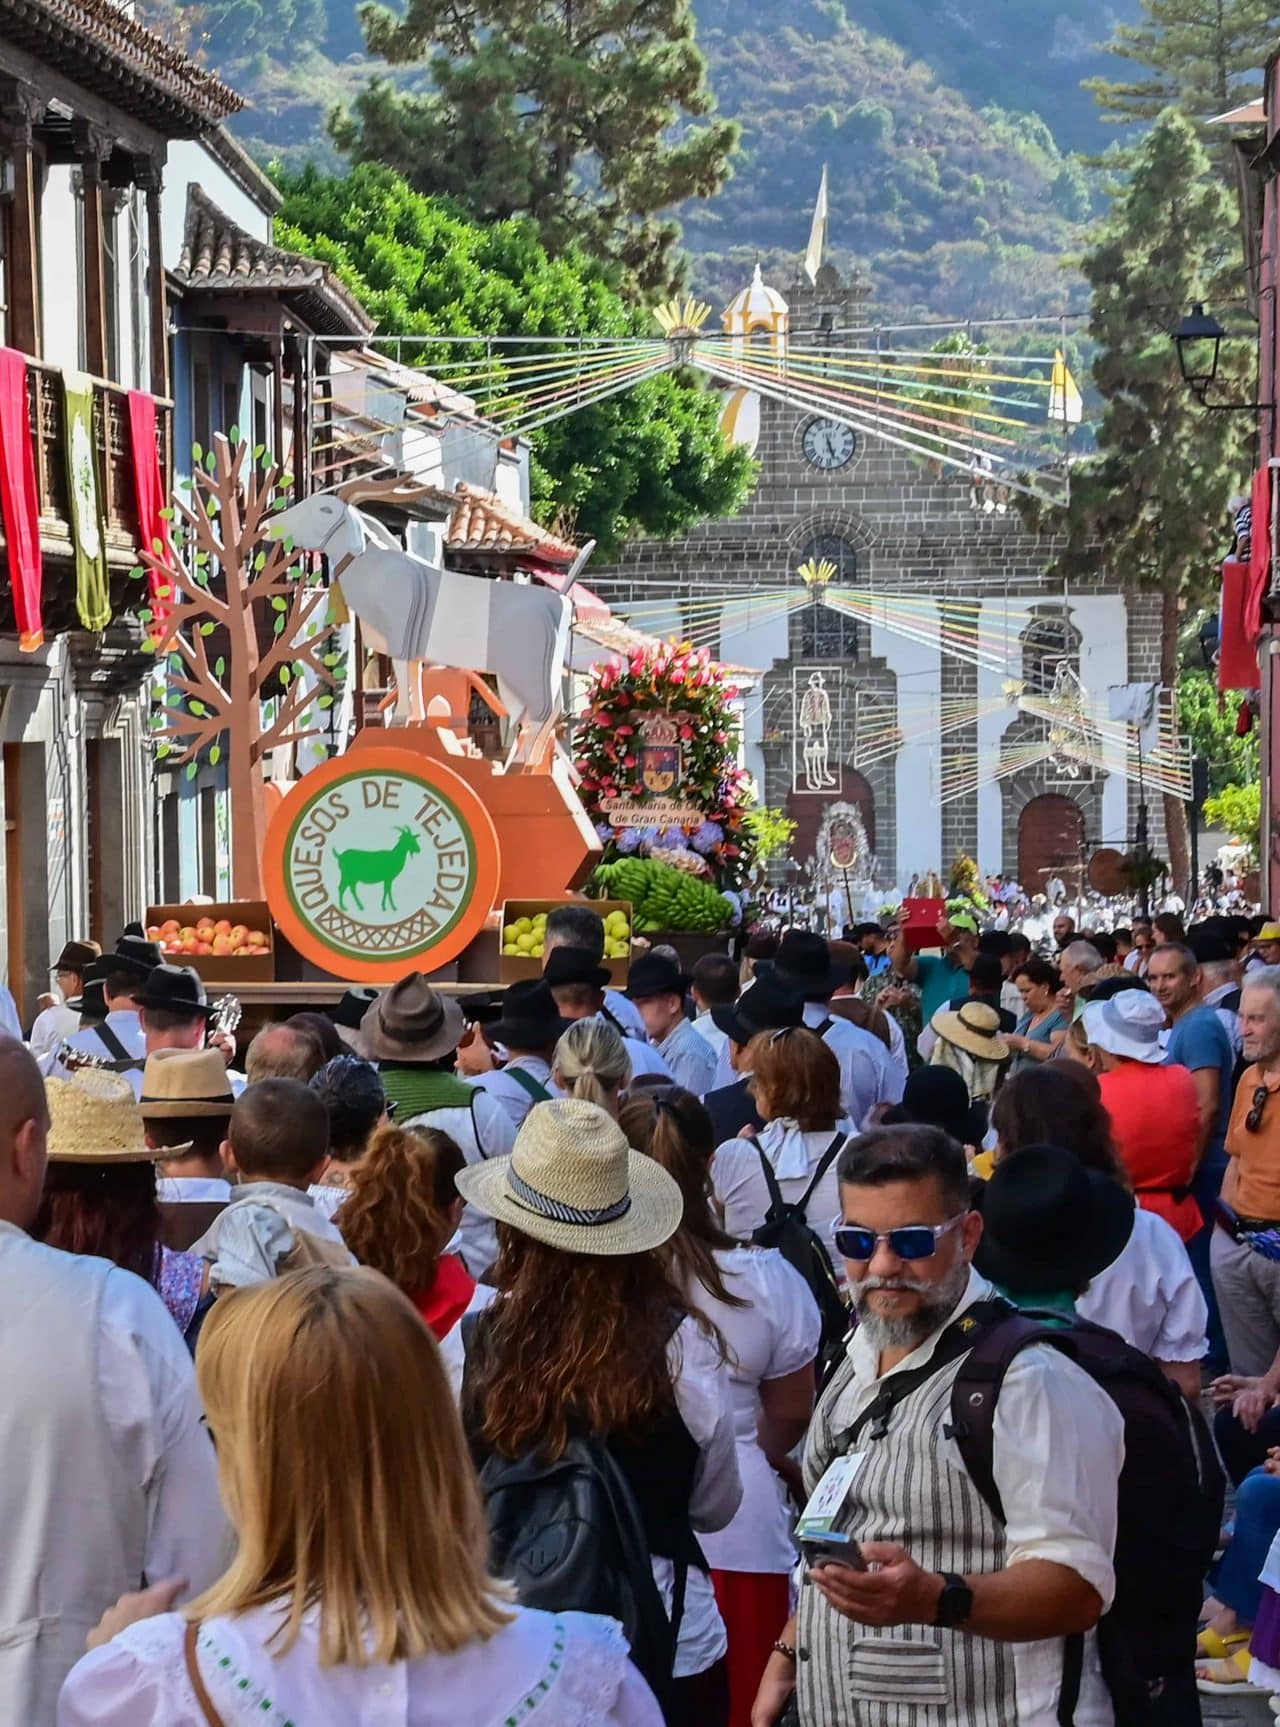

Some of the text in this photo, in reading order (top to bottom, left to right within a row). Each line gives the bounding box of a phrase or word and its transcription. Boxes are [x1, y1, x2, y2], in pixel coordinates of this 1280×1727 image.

[605, 799, 635, 810] Santa
[669, 799, 682, 811] de
[615, 813, 700, 825] de Gran Canaria
[293, 780, 466, 913] QUESOS DE TEJEDA
